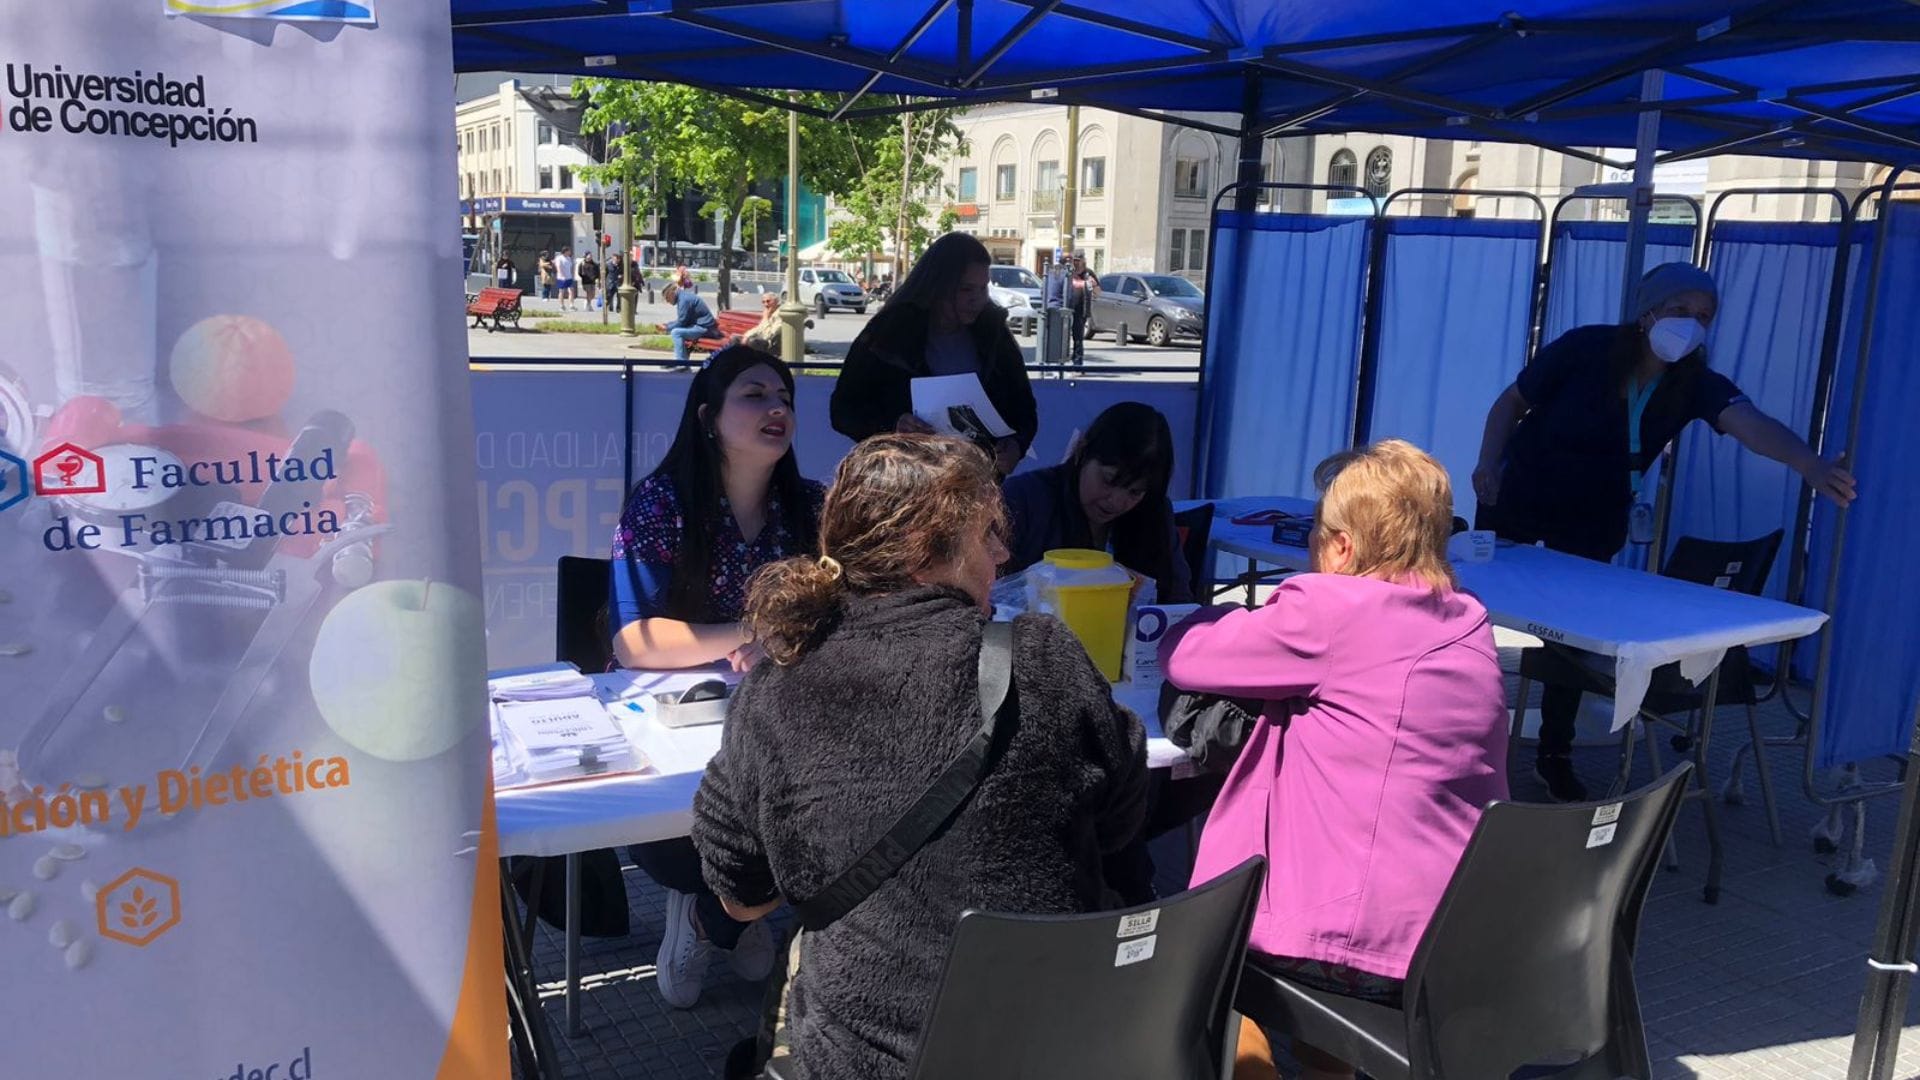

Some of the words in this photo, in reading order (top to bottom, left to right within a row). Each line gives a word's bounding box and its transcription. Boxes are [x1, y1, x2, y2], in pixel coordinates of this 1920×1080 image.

[6, 63, 205, 108] Universidad
[9, 98, 52, 133] de
[60, 100, 258, 148] Concepción
[129, 448, 338, 490] Facultad
[43, 517, 101, 552] de
[119, 501, 342, 549] Farmacia
[1527, 622, 1565, 641] CESFAM
[118, 783, 147, 834] y
[157, 750, 350, 815] Dietética
[219, 1046, 311, 1080] dec.cl
